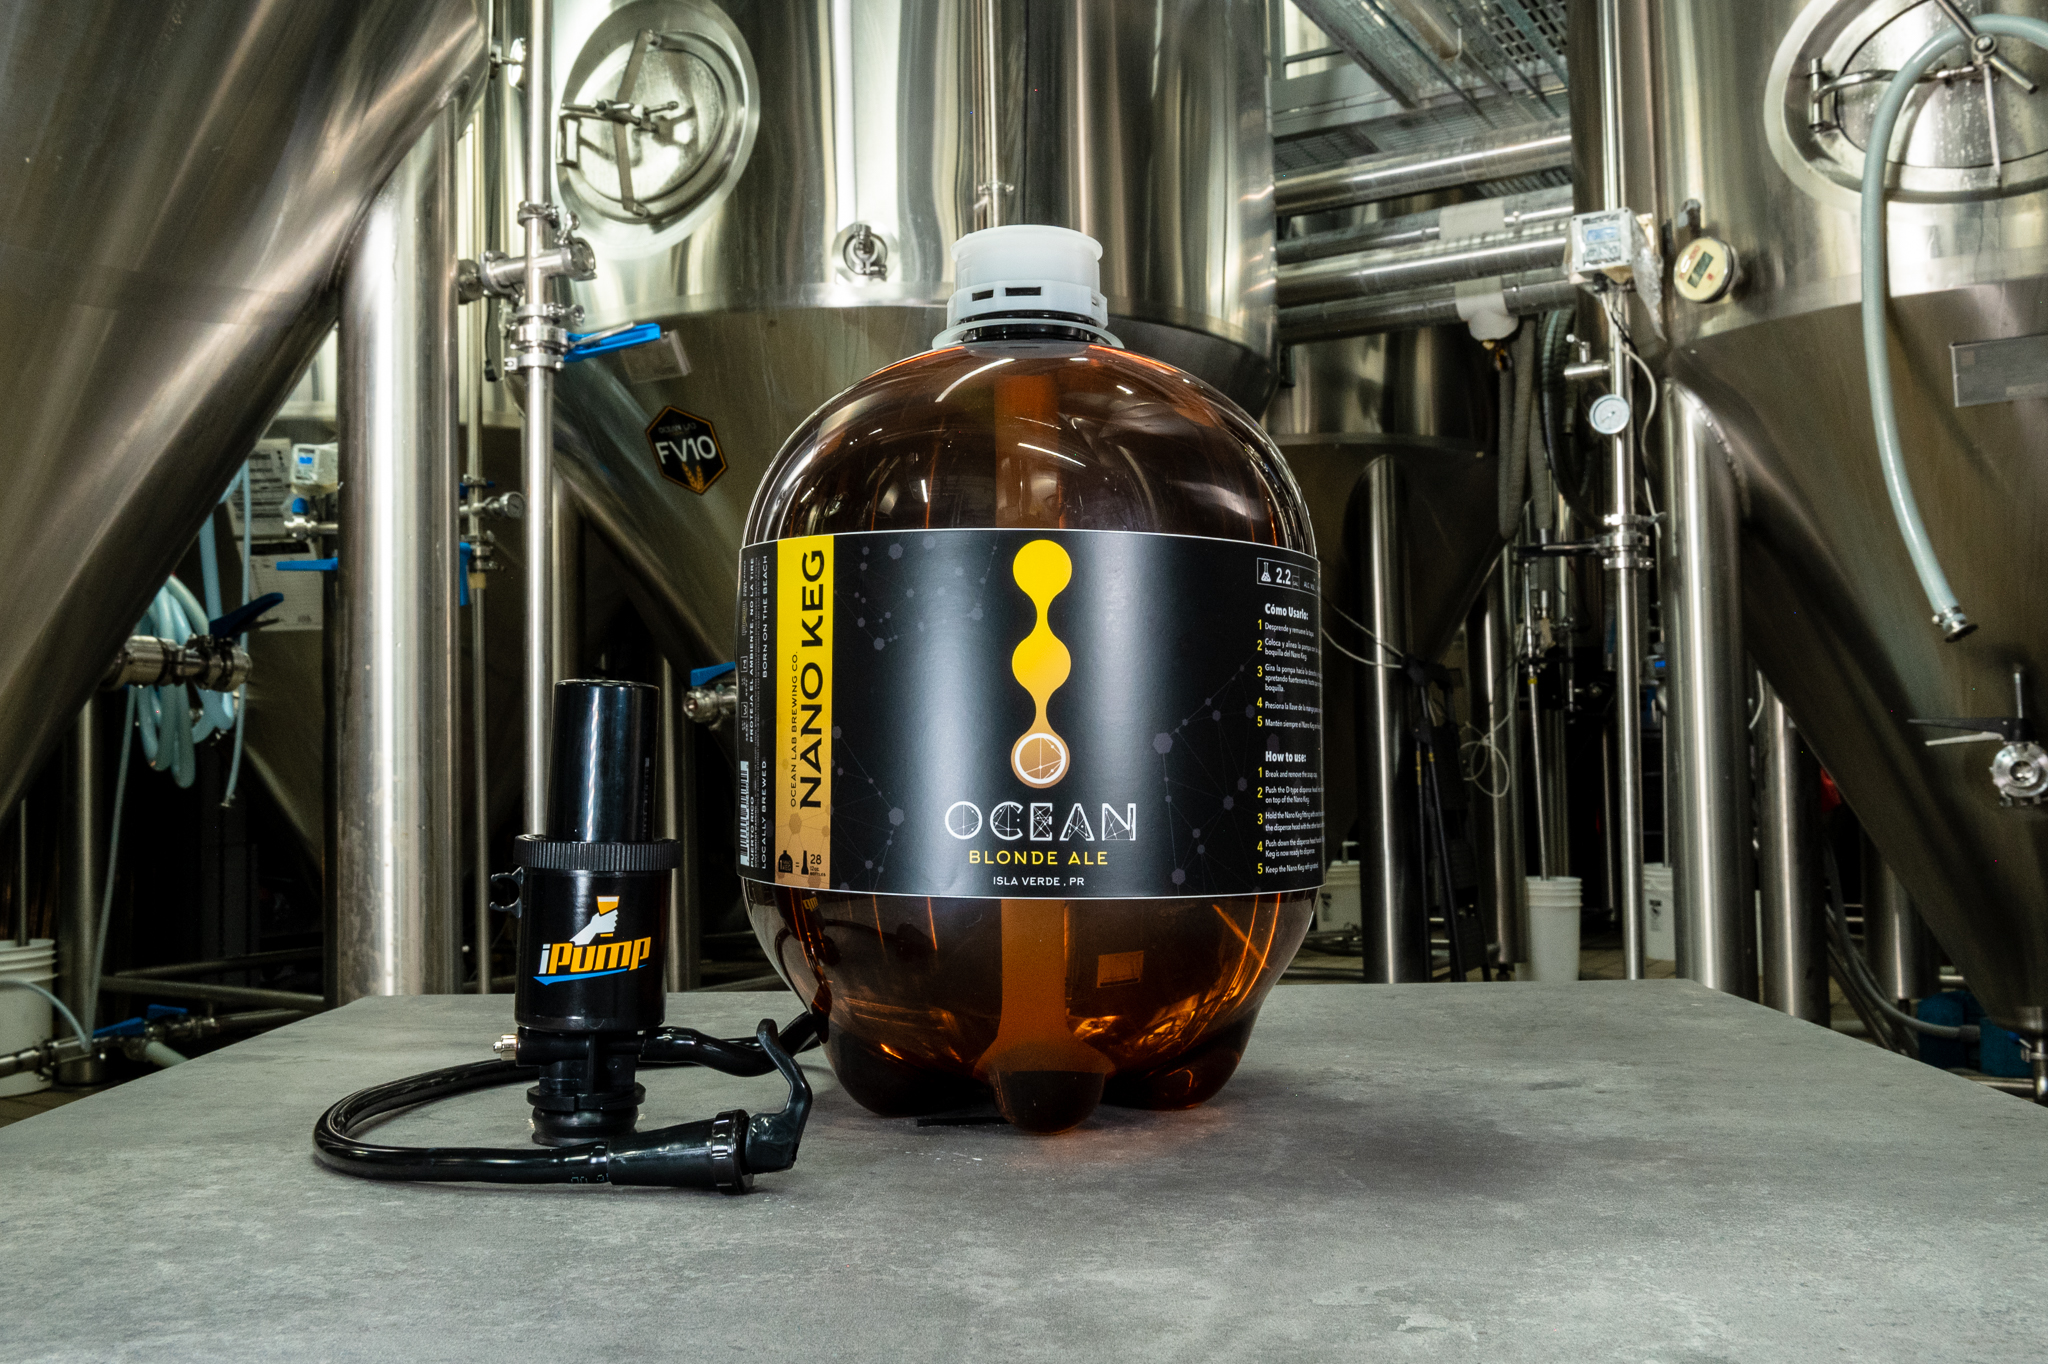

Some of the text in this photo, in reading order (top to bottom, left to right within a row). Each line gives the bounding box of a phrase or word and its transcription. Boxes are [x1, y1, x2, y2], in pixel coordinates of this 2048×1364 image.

[655, 435, 717, 465] FV10
[1276, 567, 1291, 585] 2.2
[750, 586, 754, 597] LA
[750, 601, 754, 613] NO
[1265, 603, 1308, 620] Cómo Usarlo:
[762, 624, 768, 637] ON
[1258, 619, 1262, 630] 1
[1265, 622, 1288, 632] Desprende
[1257, 640, 1262, 651] 2
[1265, 638, 1280, 648] Coloca
[1265, 648, 1283, 657] boquilla
[1257, 665, 1262, 677] 3
[1265, 664, 1275, 672] Gira
[1276, 664, 1280, 672] la
[750, 678, 754, 691] EL
[800, 550, 825, 809] NANO KEG
[1265, 675, 1288, 683] apretando
[1257, 697, 1262, 708] 4
[1265, 701, 1284, 709] Presiona
[1257, 716, 1262, 727] 5
[1265, 751, 1306, 762] How to use:
[1258, 767, 1262, 778] 1
[1265, 770, 1279, 778] Break
[1280, 770, 1288, 778] and
[1257, 787, 1262, 798] 2
[1282, 795, 1286, 803] of
[945, 801, 1137, 841] OCEAN
[1257, 813, 1263, 824] 3
[1265, 811, 1277, 819] Hold
[1285, 811, 1295, 819] Nano
[1265, 823, 1273, 831] the
[1257, 841, 1263, 852] 4
[1265, 839, 1277, 847] Push
[810, 854, 822, 865] 28
[969, 850, 1108, 865] BLONDE ALE
[1265, 850, 1275, 859] Keg
[1257, 863, 1263, 874] 5
[1265, 866, 1278, 875] Keep
[993, 876, 1018, 886] ISLA
[1069, 877, 1085, 886] PR
[538, 936, 652, 975] iPump
